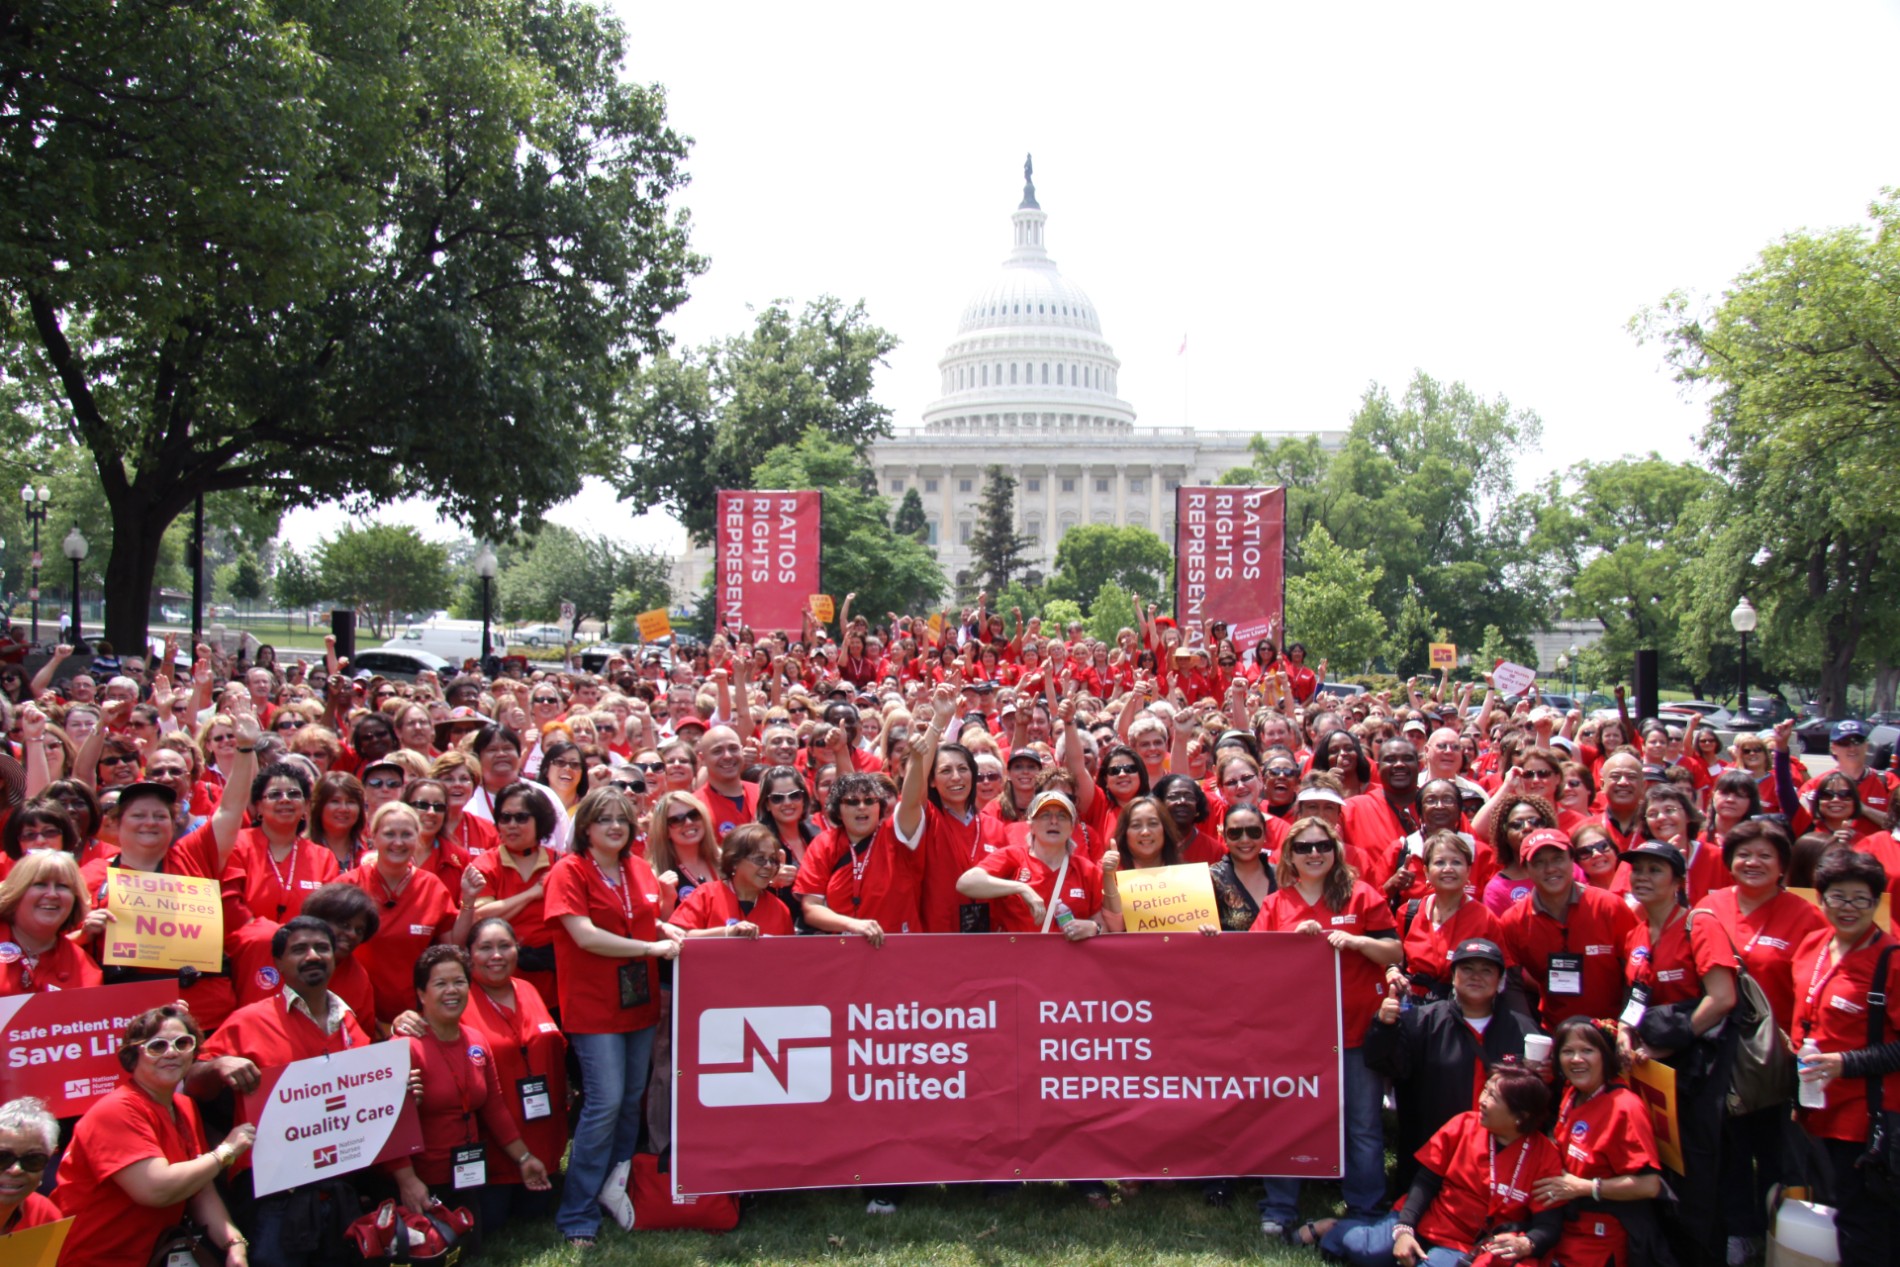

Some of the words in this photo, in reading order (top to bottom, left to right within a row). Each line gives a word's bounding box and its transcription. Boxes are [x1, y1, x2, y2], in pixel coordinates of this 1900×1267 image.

[751, 499, 771, 583] RIGHTS
[778, 499, 797, 583] RATIOS
[1215, 494, 1233, 580] RIGHTS
[1242, 494, 1261, 580] RATIOS
[1528, 833, 1555, 845] USA
[116, 873, 199, 896] Rights
[1129, 883, 1153, 893] I'm
[1158, 881, 1167, 889] a
[118, 893, 151, 908] V.A.
[157, 898, 215, 915] Nurses
[1132, 893, 1188, 912] Patient
[135, 914, 203, 940] Now
[1137, 908, 1210, 931] Advocate
[848, 1000, 997, 1031] National
[1039, 1000, 1153, 1024] RATIOS
[8, 1026, 47, 1042] Safe
[51, 1018, 110, 1037] Patient
[8, 1042, 82, 1068] Save
[848, 1037, 969, 1066] Nurses
[1040, 1037, 1152, 1061] RIGHTS
[92, 1074, 119, 1082] National
[278, 1081, 333, 1104] Union
[337, 1067, 394, 1091] Nurses
[848, 1070, 966, 1102] United
[1040, 1075, 1320, 1100] REPRESENTATION
[285, 1114, 351, 1142] Quality
[356, 1104, 395, 1124] Care
[338, 1135, 365, 1149] National
[338, 1145, 361, 1155] Nurses
